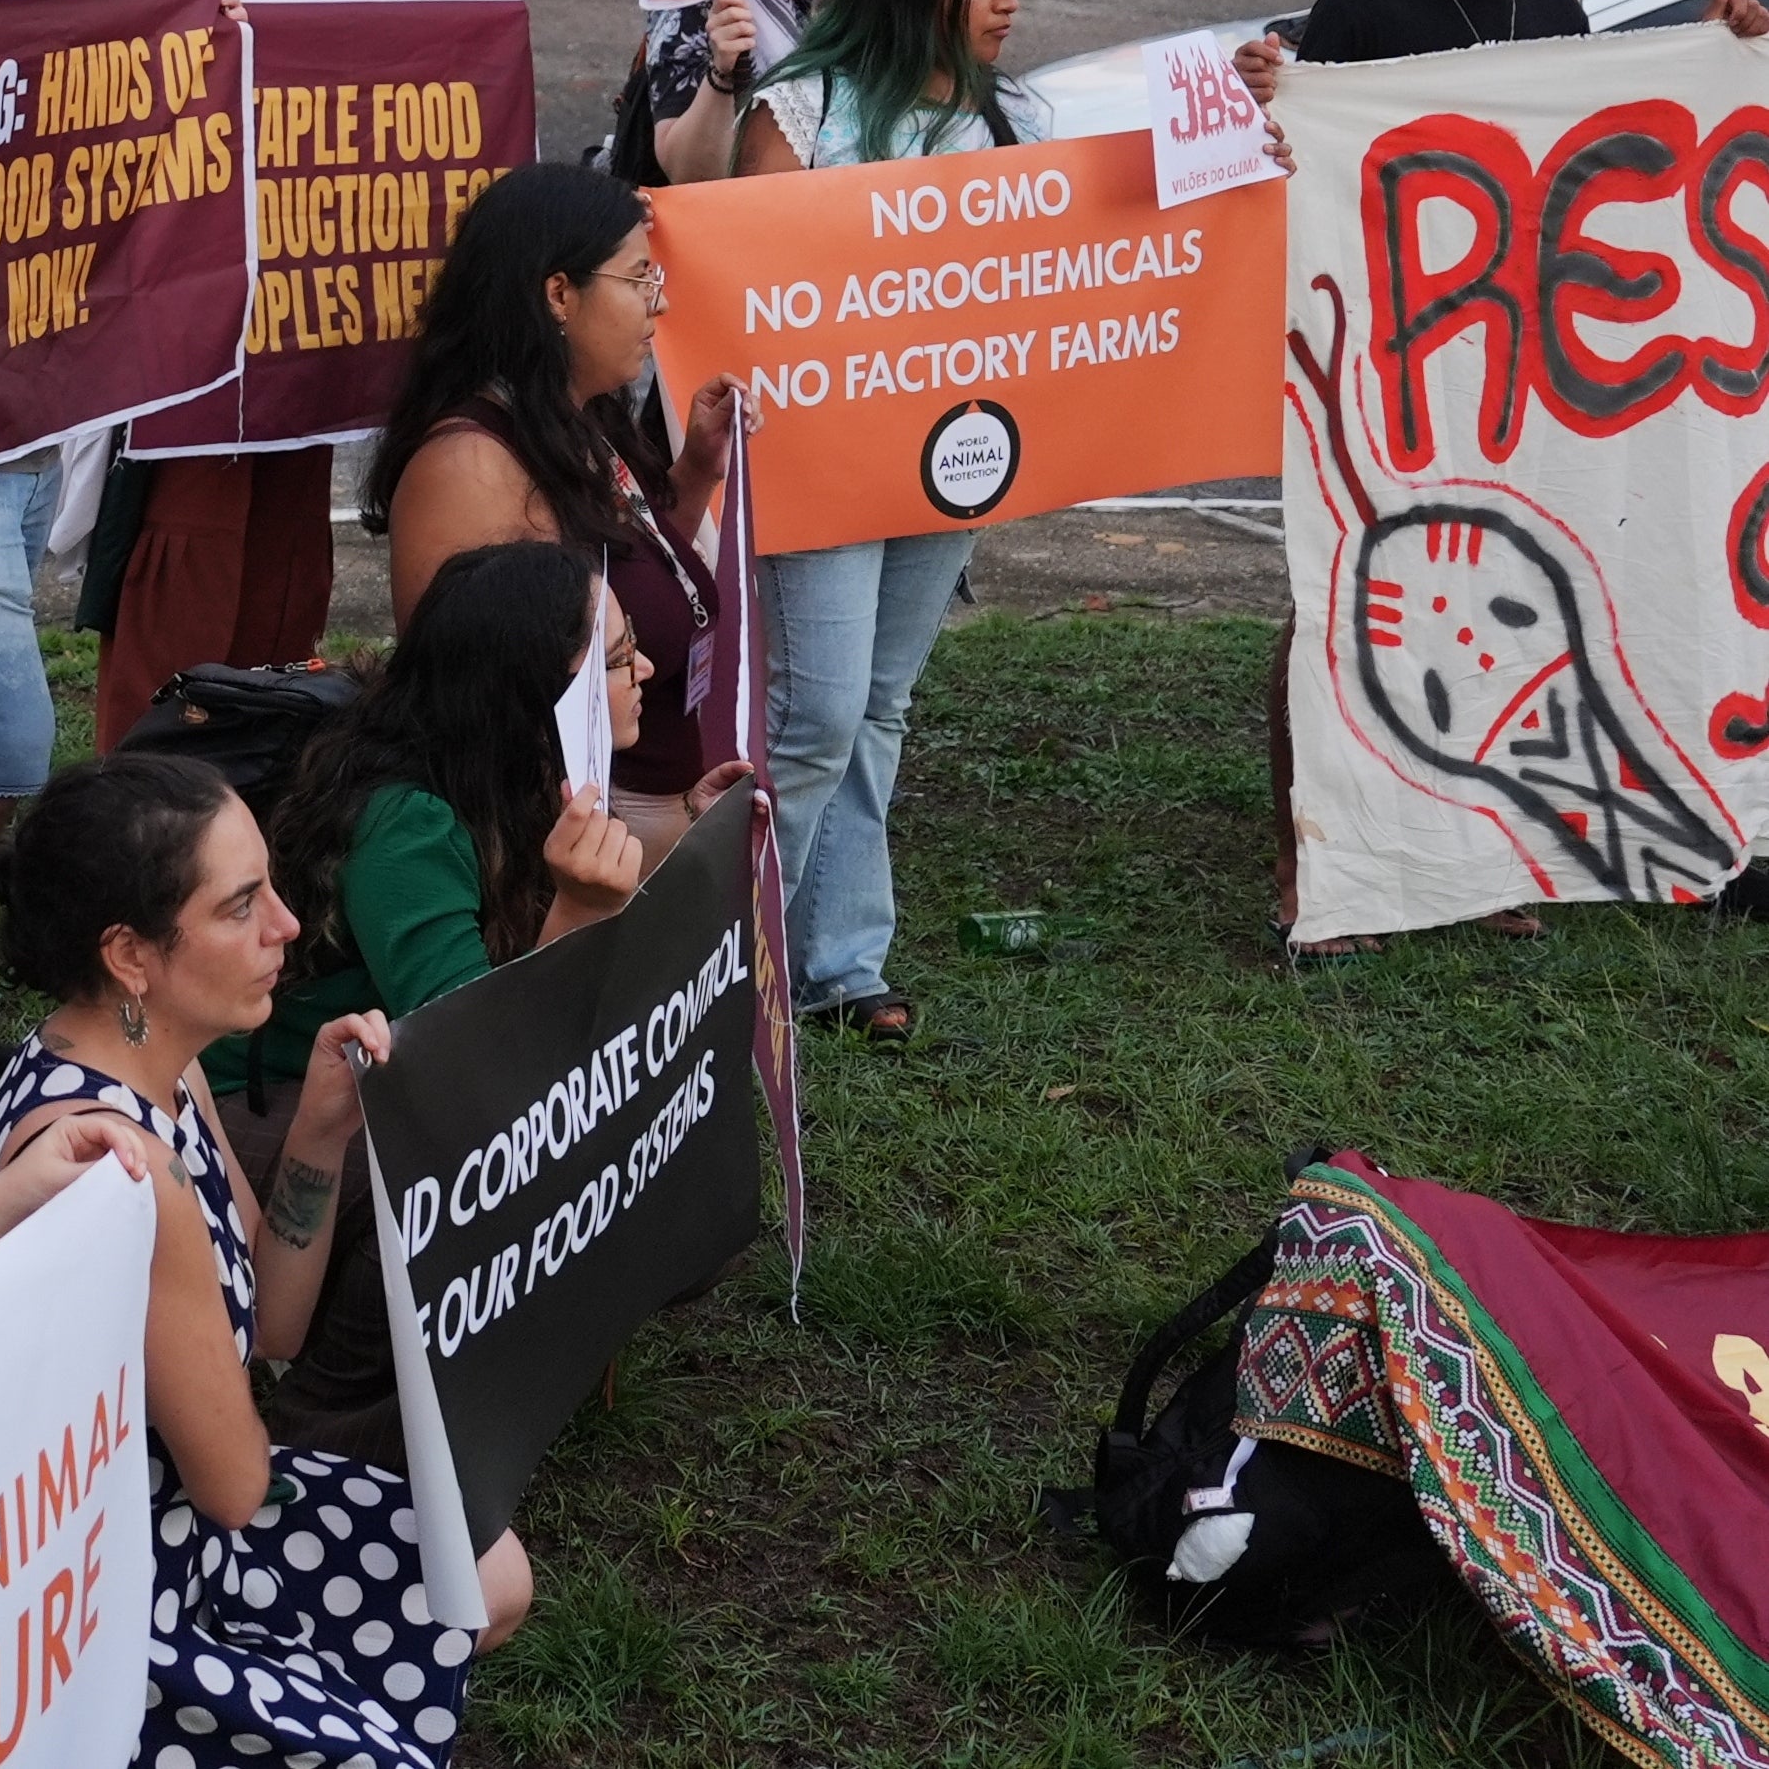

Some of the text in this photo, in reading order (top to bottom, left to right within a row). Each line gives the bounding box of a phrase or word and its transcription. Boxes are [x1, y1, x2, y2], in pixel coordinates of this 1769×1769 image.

[35, 35, 152, 137] HANDS
[253, 80, 482, 169] APLE FOOD
[1165, 50, 1256, 144] JBS
[871, 168, 1072, 238] NO GMO
[1171, 171, 1208, 196] VILÕES
[1210, 167, 1225, 184] DO
[6, 242, 98, 348] NOW!
[744, 228, 1204, 335] NO AGROCHEMICALS
[750, 307, 1181, 410] NO FACTORY FARMS
[938, 445, 1004, 471] ANIMAL
[943, 466, 999, 483] PROTECTION
[956, 435, 989, 448] WORLD
[449, 1023, 640, 1227] CORPORATE
[645, 919, 749, 1078] CONTROL
[437, 1049, 716, 1358] OUR FOOD SYSTEMS
